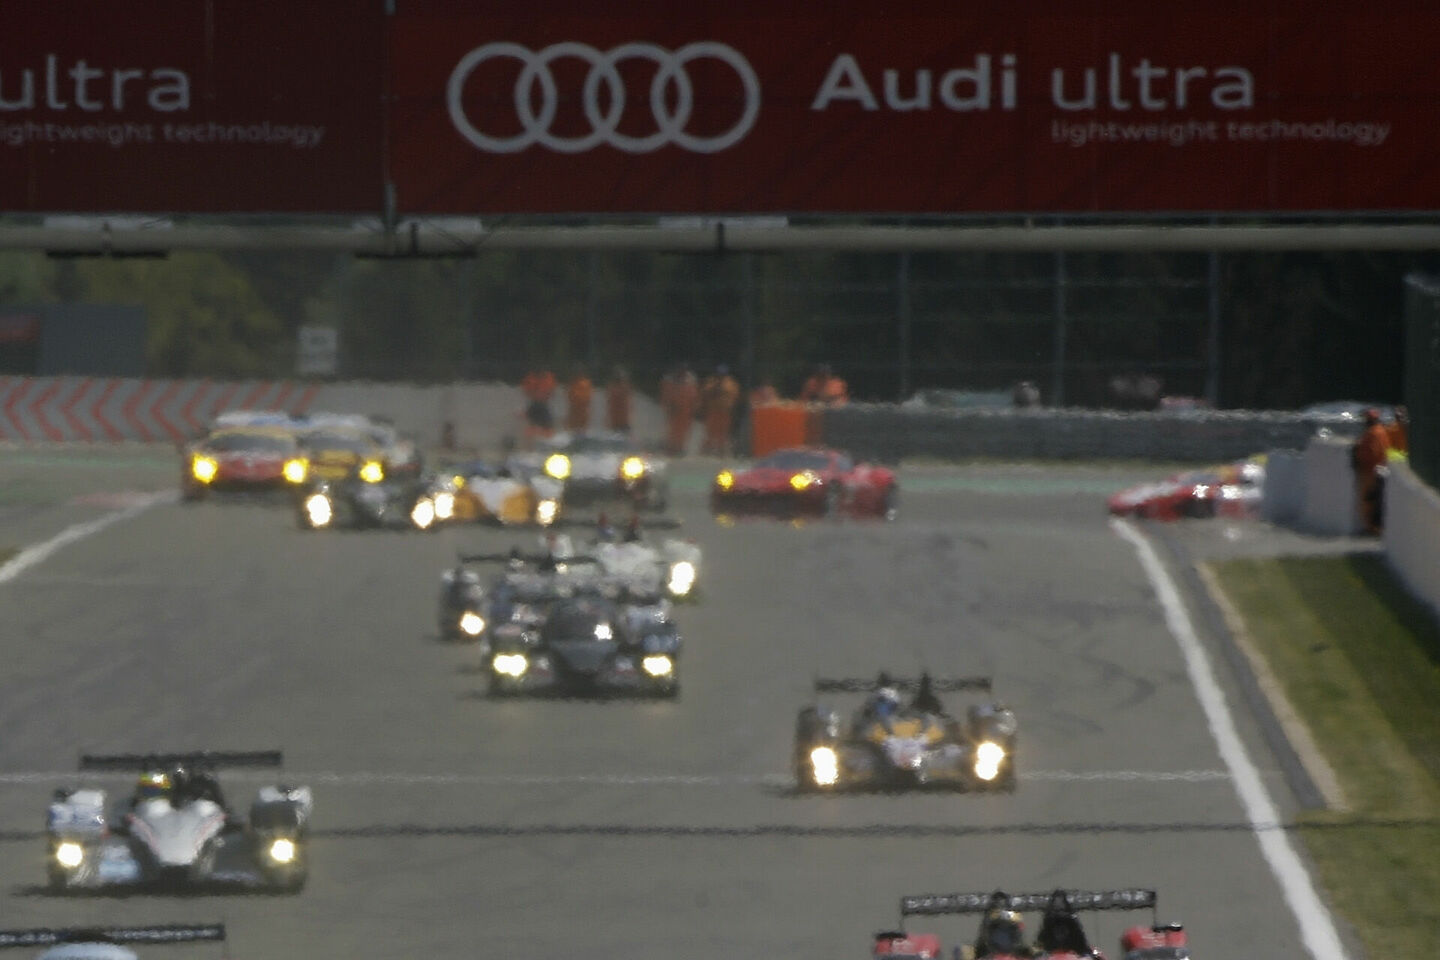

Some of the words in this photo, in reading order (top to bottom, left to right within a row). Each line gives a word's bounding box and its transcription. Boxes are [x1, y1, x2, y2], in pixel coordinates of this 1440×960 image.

[809, 52, 1016, 110] Audi
[1050, 53, 1254, 111] ultra
[163, 120, 325, 147] technology
[1051, 119, 1217, 147] lightweight
[1227, 119, 1391, 147] technology
